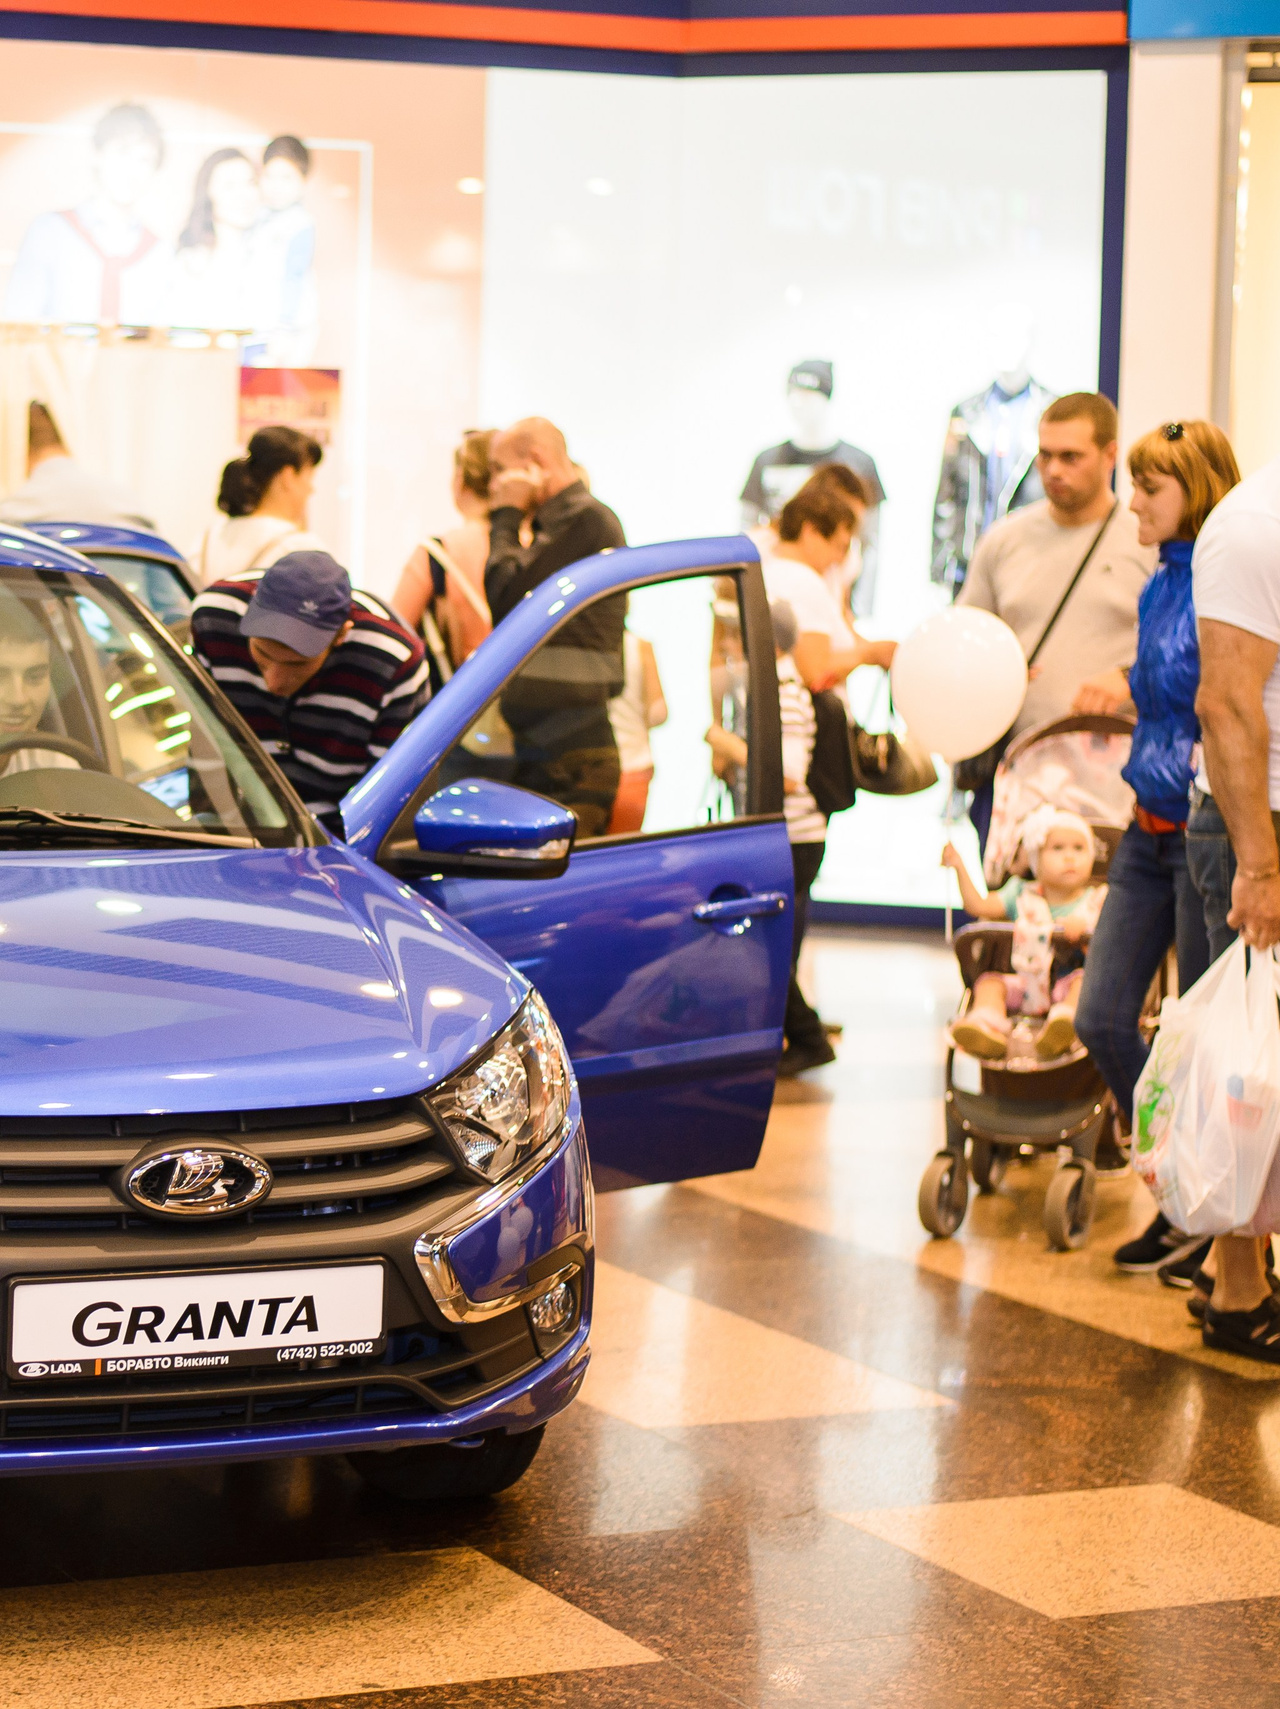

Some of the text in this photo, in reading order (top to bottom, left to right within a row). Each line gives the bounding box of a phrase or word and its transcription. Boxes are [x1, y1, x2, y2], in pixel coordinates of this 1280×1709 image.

[71, 1295, 319, 1348] GRANTA
[276, 1341, 374, 1362] (4742) 522-002
[50, 1363, 82, 1374] LADA
[106, 1355, 230, 1372] БОРАВТО Викинги
